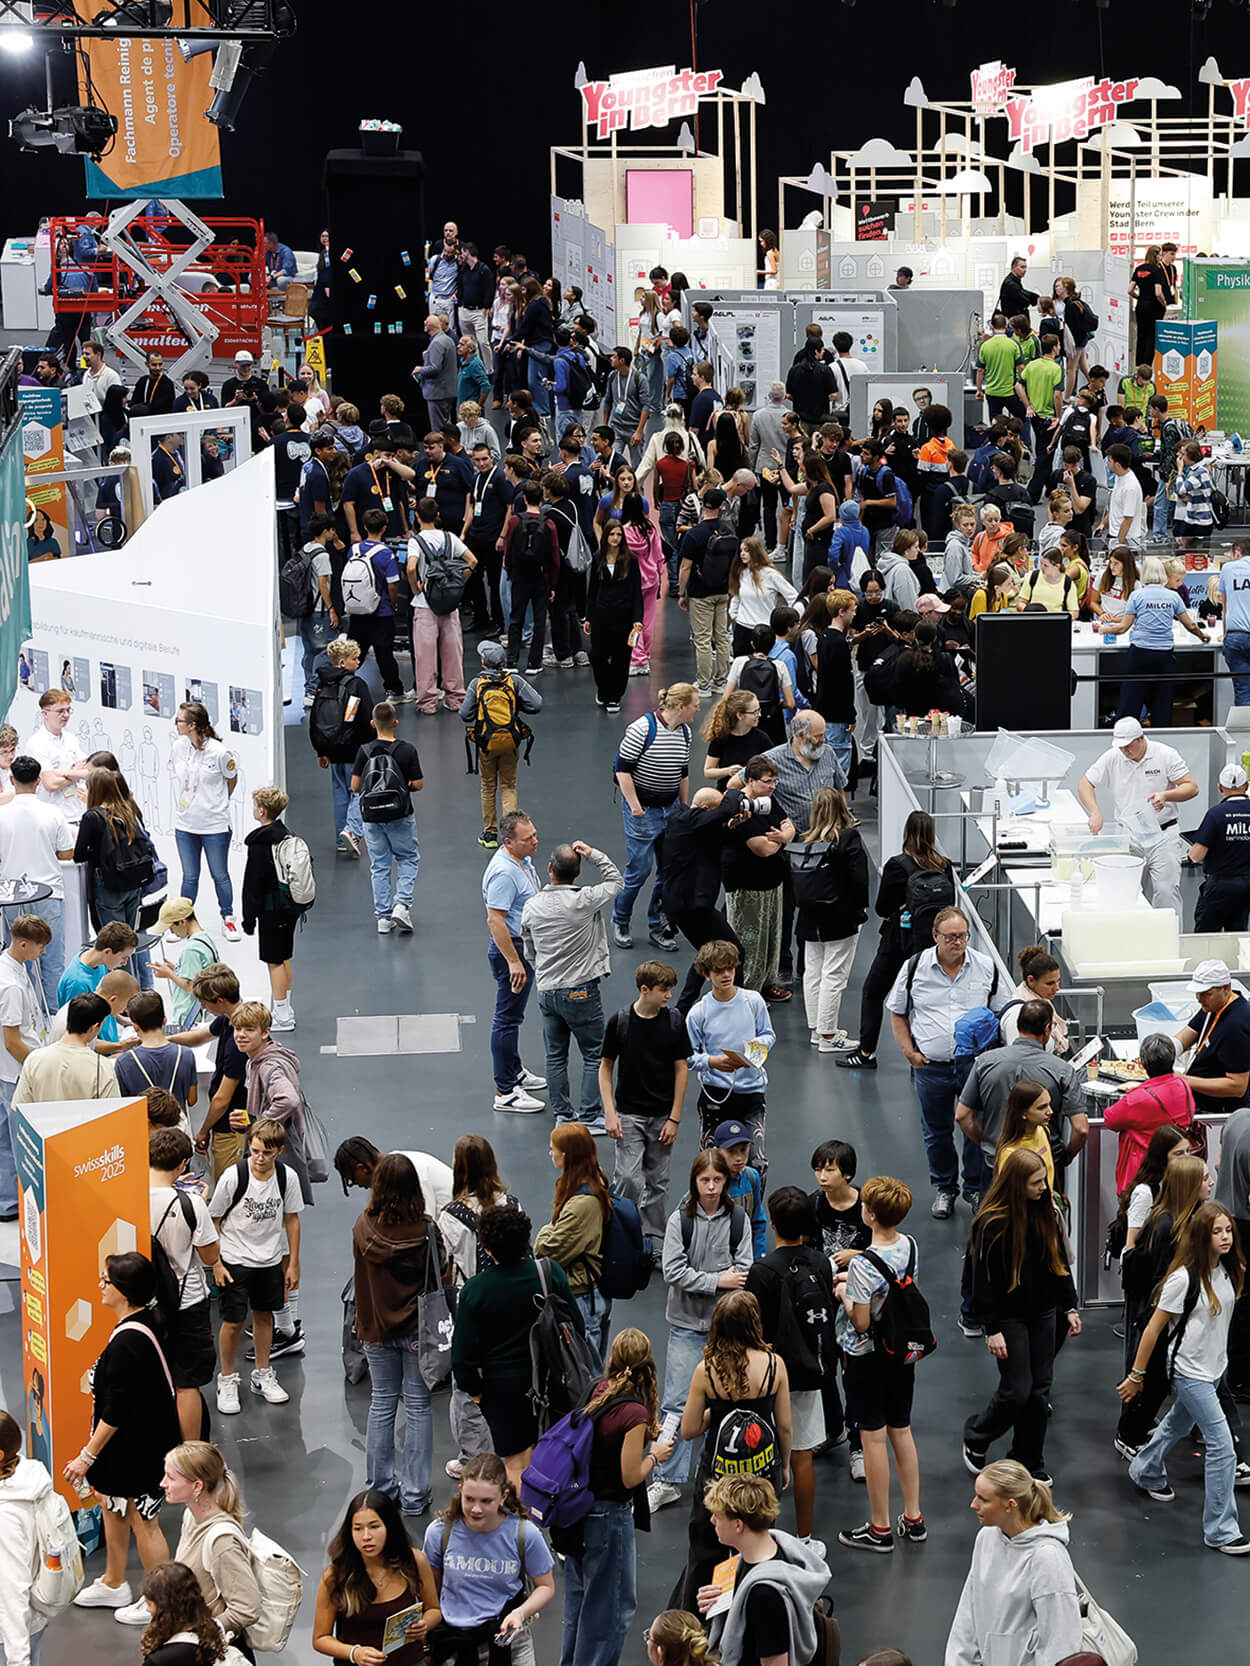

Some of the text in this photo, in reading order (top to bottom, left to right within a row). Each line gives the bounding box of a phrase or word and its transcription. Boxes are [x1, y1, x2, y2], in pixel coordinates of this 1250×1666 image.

[141, 58, 159, 124] Agent de
[582, 70, 721, 121] Youngster
[1005, 80, 1139, 138] Yogster
[124, 88, 136, 164] Fachmann
[167, 83, 182, 158] Operatore
[600, 94, 696, 137] in Bern
[1110, 210, 1152, 218] Younster
[1186, 208, 1200, 216] der
[1110, 220, 1129, 228] Stad
[73, 1144, 125, 1178] swissskills
[100, 1159, 126, 1183] 2025
[444, 1554, 519, 1576] AMOUR
